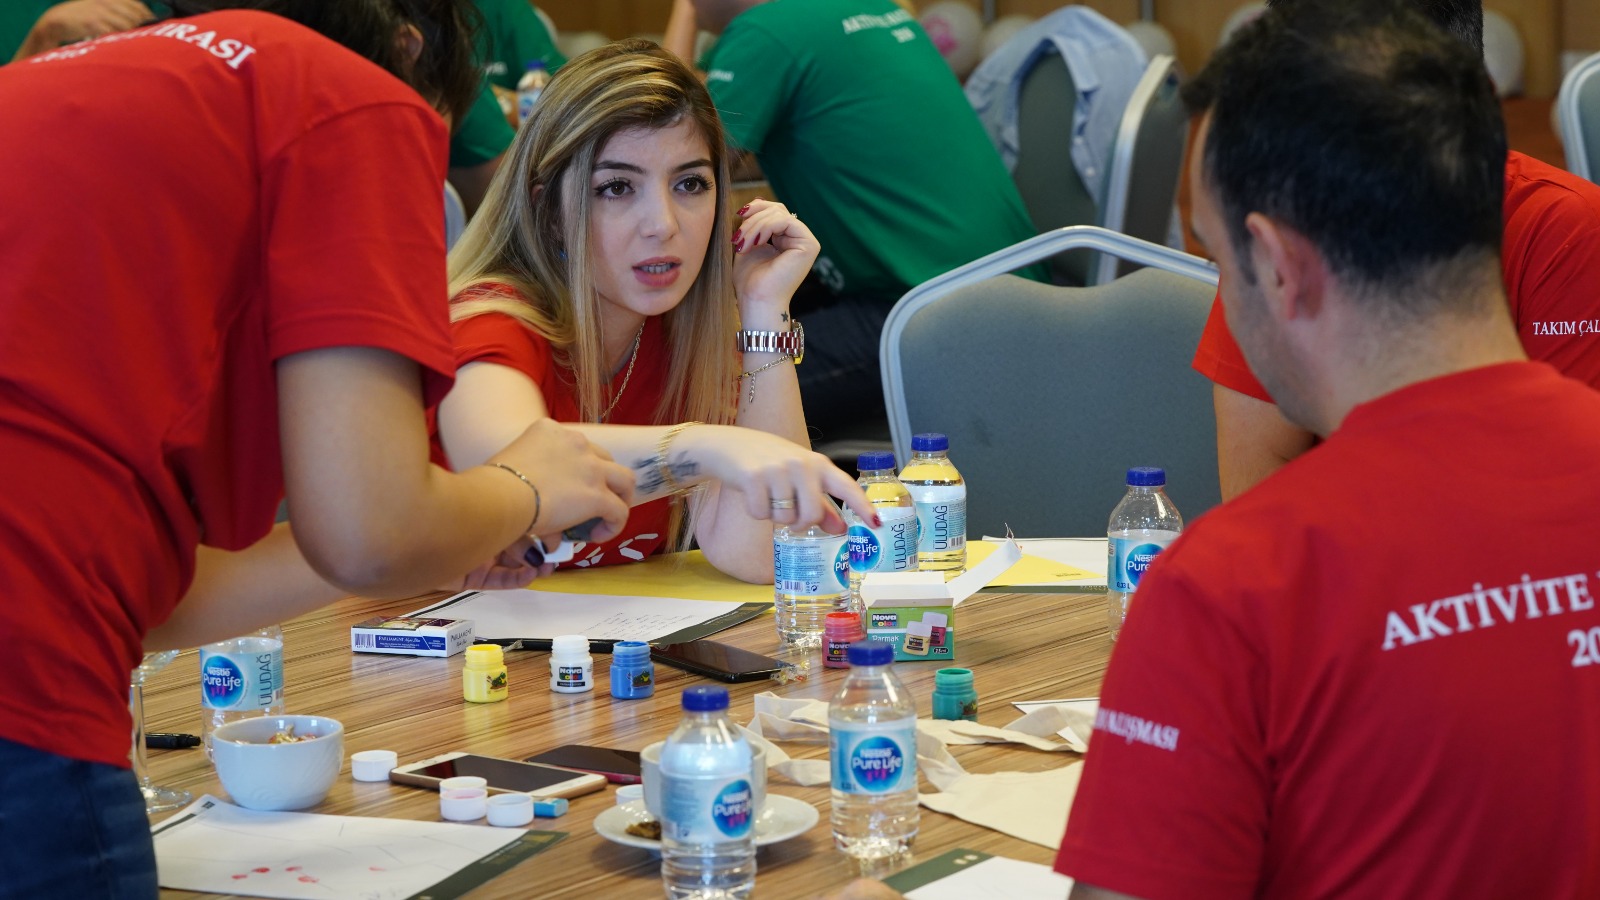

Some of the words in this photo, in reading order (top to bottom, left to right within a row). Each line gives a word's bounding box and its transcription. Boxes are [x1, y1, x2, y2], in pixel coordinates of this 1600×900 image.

[1532, 321, 1576, 336] TAKIM
[933, 505, 948, 550] ULUDAĞ
[862, 544, 878, 557] Life
[891, 523, 907, 570] ULUDAĞ
[1381, 573, 1594, 651] AKTİVİTE
[872, 634, 900, 642] Parmak
[203, 673, 222, 687] Pure
[222, 676, 242, 690] Life
[256, 653, 272, 706] ULUDAĞ
[852, 757, 881, 770] Pure
